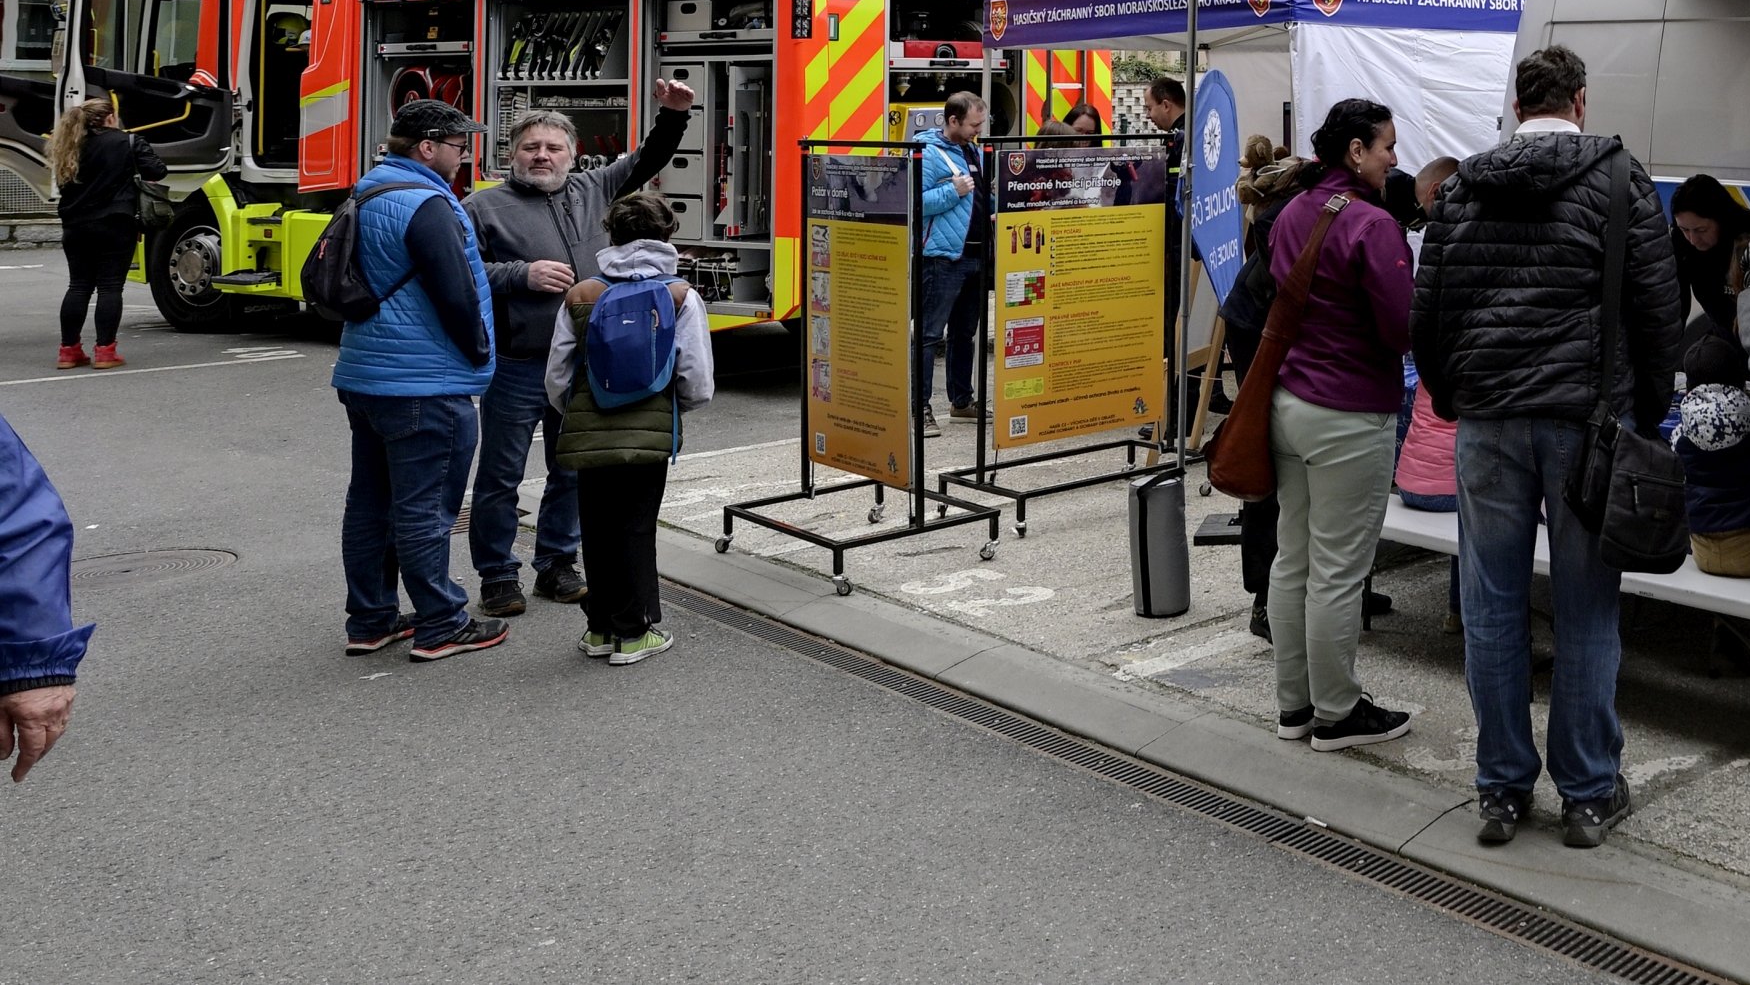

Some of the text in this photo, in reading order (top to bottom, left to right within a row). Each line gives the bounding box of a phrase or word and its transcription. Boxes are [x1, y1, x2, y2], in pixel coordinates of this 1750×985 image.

[1013, 6, 1046, 26] HASIČSKÝ
[1047, 3, 1093, 23] ZÁCHRANNÝ
[1094, 3, 1116, 18] SBOR
[1007, 176, 1122, 192] Přenosné hasicí přístroje
